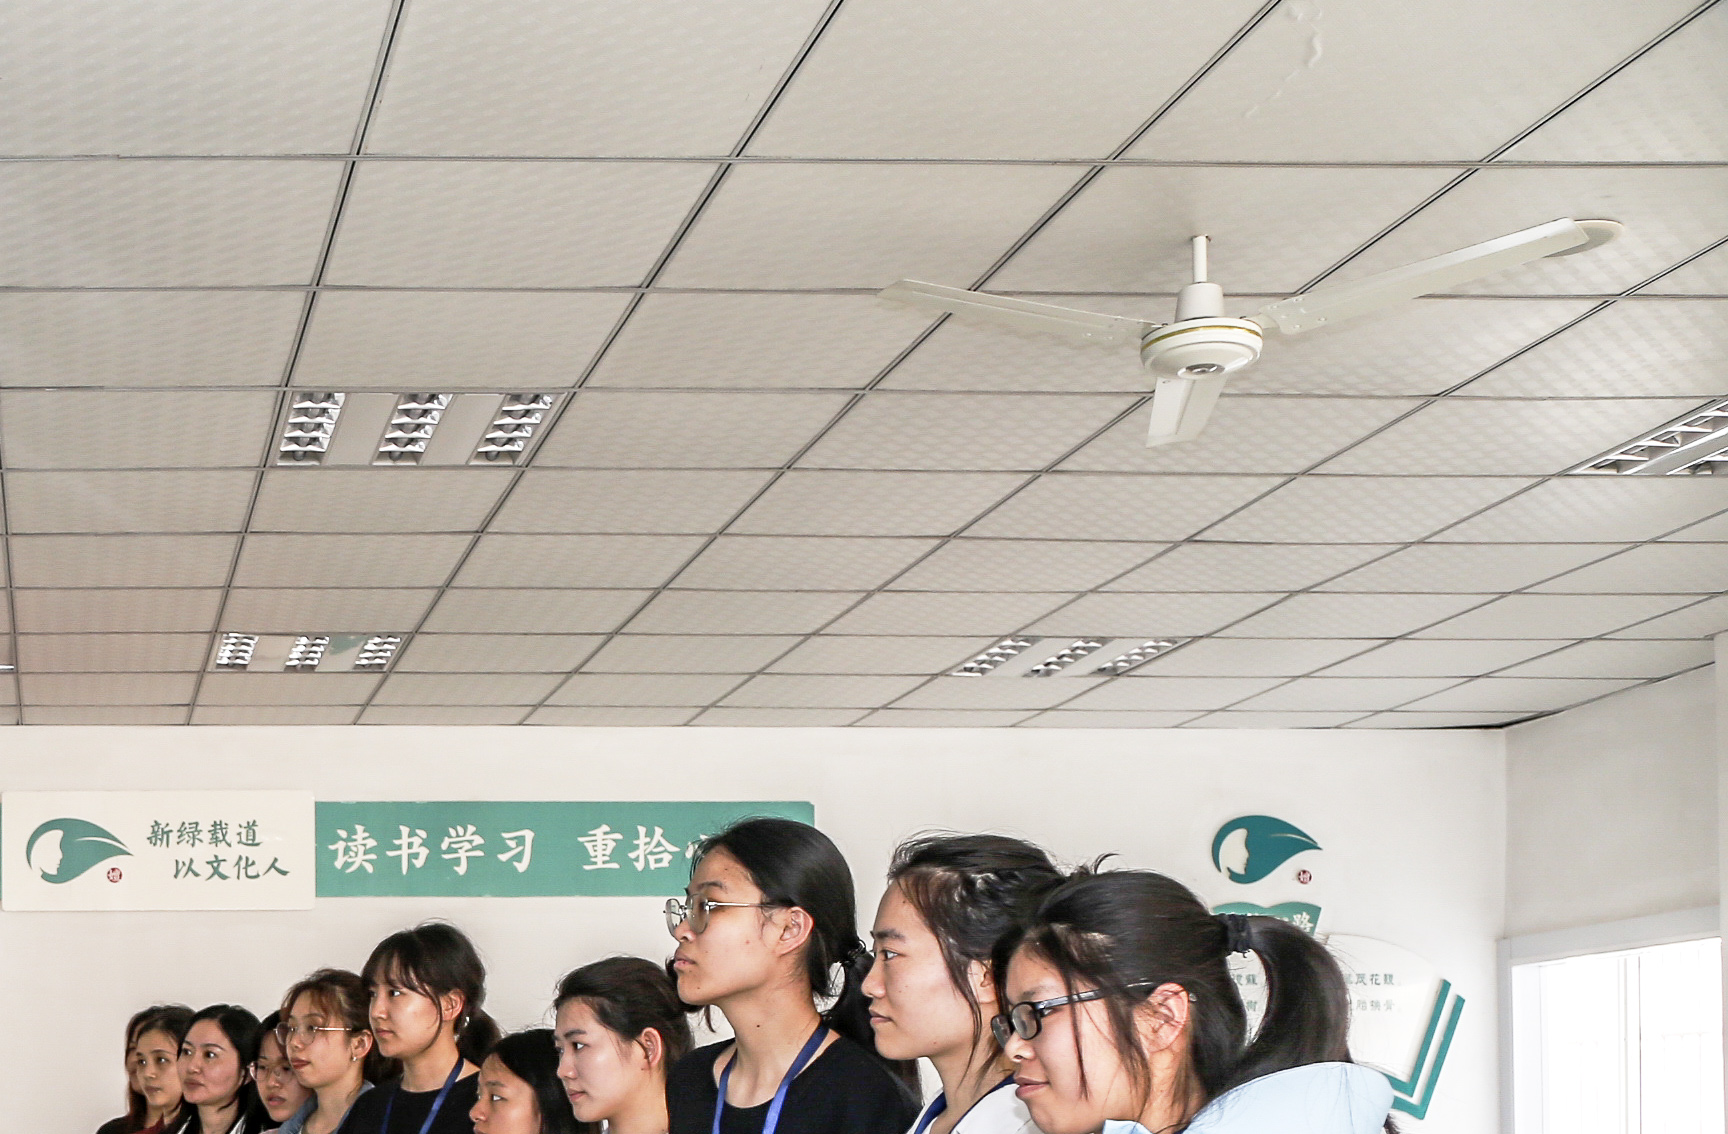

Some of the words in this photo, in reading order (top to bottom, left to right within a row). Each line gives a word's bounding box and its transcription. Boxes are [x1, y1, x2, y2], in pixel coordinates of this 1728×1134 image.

[146, 819, 264, 849] 新绿载道
[328, 823, 535, 875] 读书学习
[577, 823, 709, 873] 重拾
[173, 854, 291, 881] 以文化人
